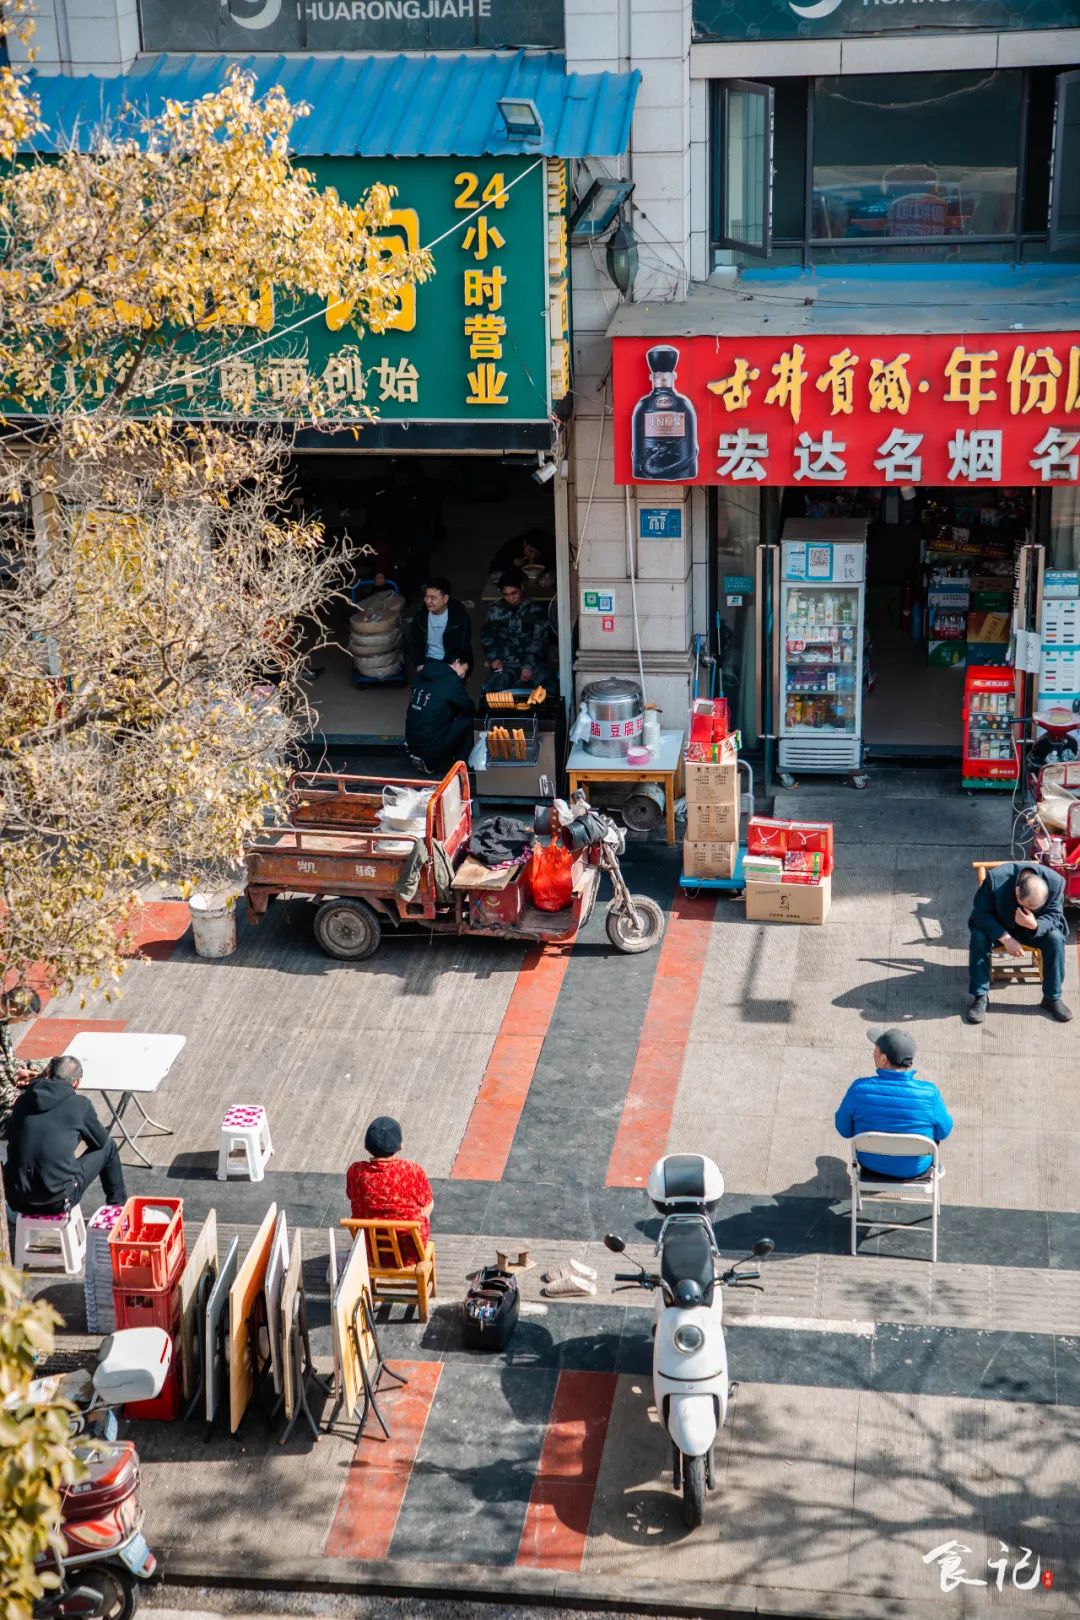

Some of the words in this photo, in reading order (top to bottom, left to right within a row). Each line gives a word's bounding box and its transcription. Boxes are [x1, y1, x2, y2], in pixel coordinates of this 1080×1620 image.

[297, 0, 491, 20] HUARONGJIAHE
[454, 171, 510, 405] 24小时营业
[716, 427, 1080, 482] 宏达名烟名
